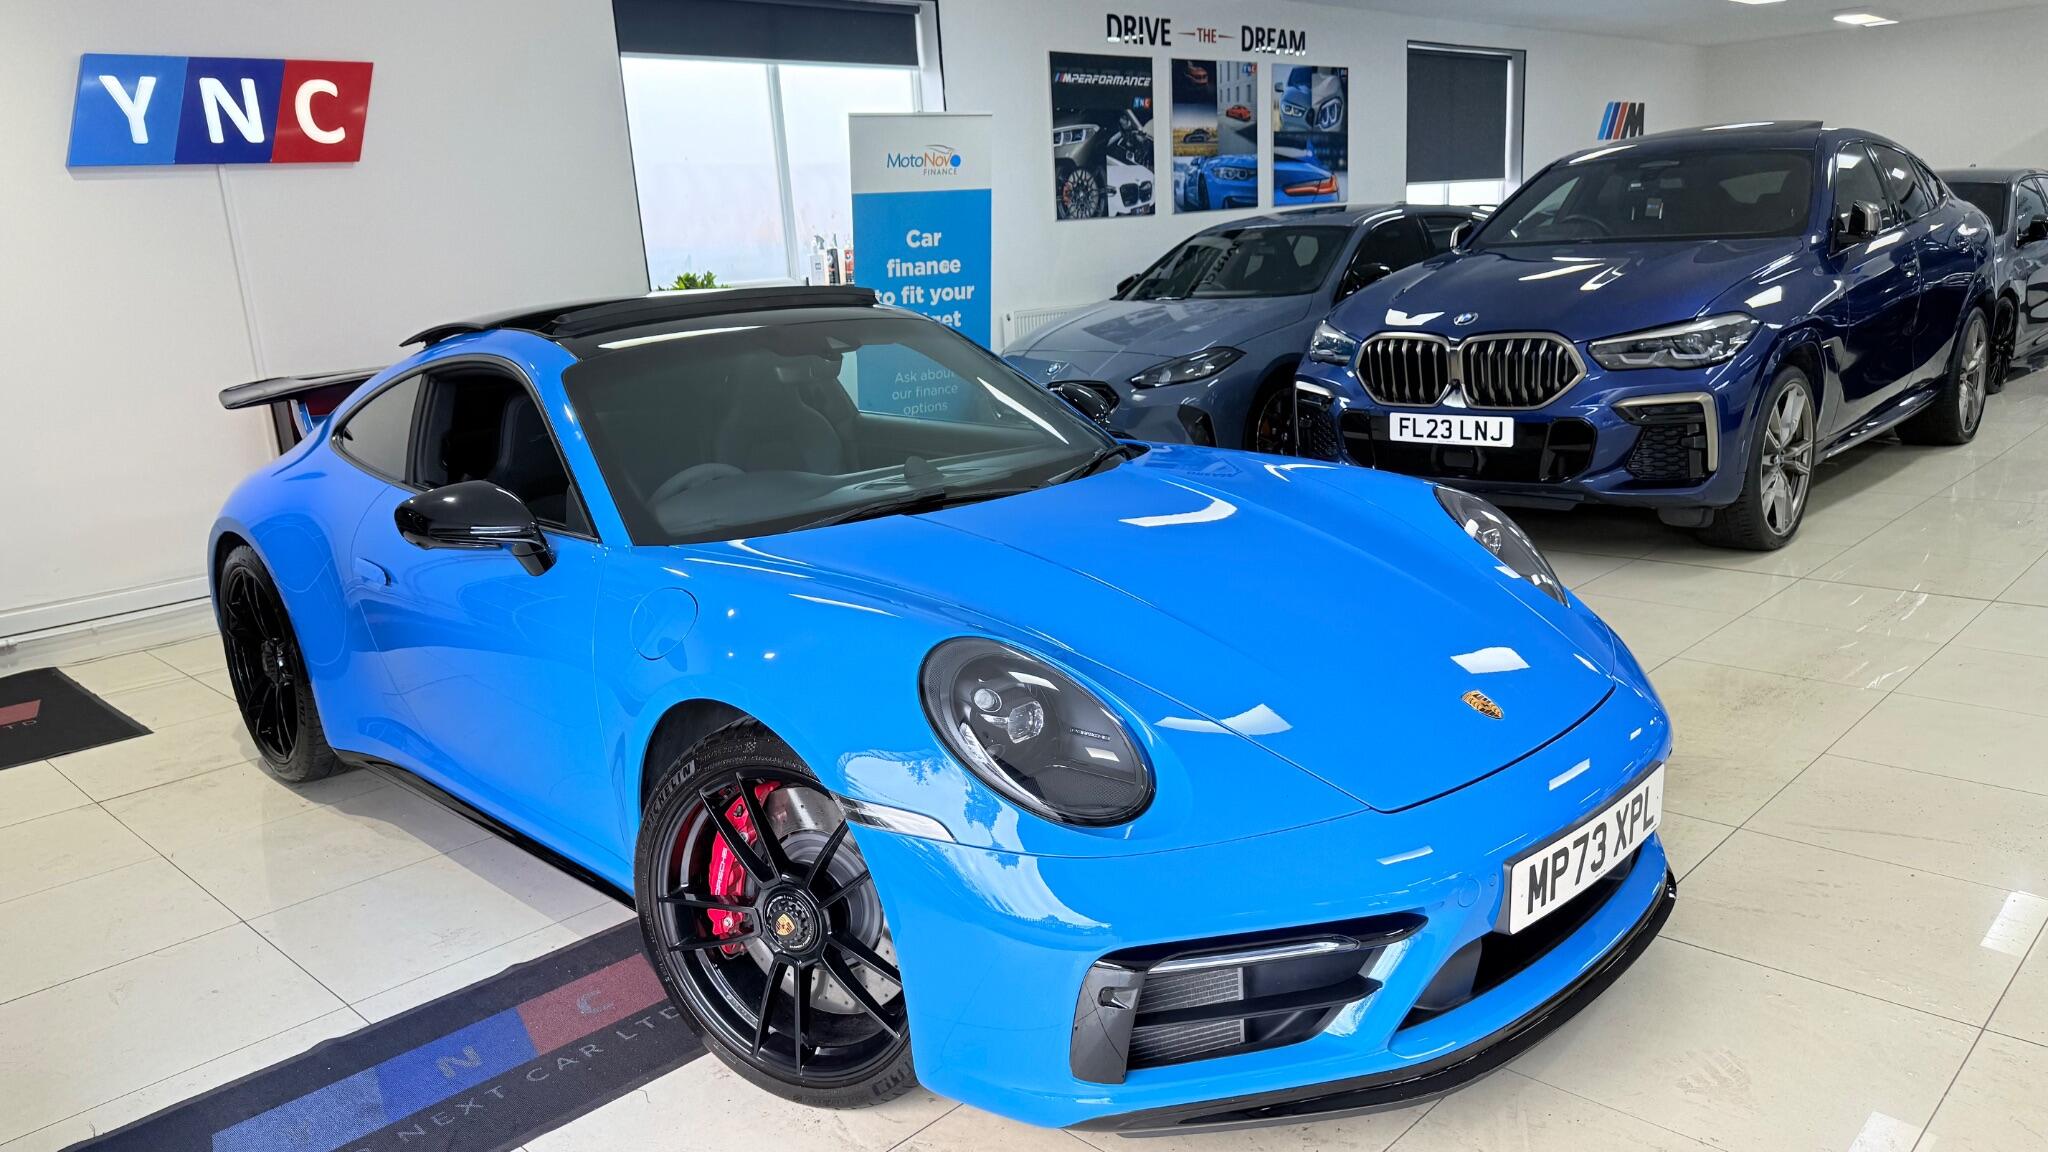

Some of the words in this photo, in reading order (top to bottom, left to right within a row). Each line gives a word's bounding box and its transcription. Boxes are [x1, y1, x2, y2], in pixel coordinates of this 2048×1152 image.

[1106, 13, 1171, 46] DRIVE
[1196, 27, 1217, 43] THE
[1241, 25, 1306, 56] DREAM
[99, 75, 346, 144] YNC
[923, 168, 958, 176] FINANCE
[906, 229, 942, 248] Car
[886, 258, 961, 278] finance
[874, 289, 896, 306] to
[901, 286, 925, 305] fit
[929, 285, 975, 306] your
[895, 370, 917, 384] Ask
[891, 390, 912, 401] our
[916, 384, 959, 398] finance
[903, 401, 949, 416] options
[1399, 417, 1453, 439] FL23
[1459, 419, 1503, 441] LNJ
[1527, 820, 1608, 916] MP73
[1613, 785, 1654, 858] XPL
[714, 846, 729, 896] ORSCHE
[396, 1084, 505, 1144] NEXT
[525, 1043, 604, 1082] CAR
